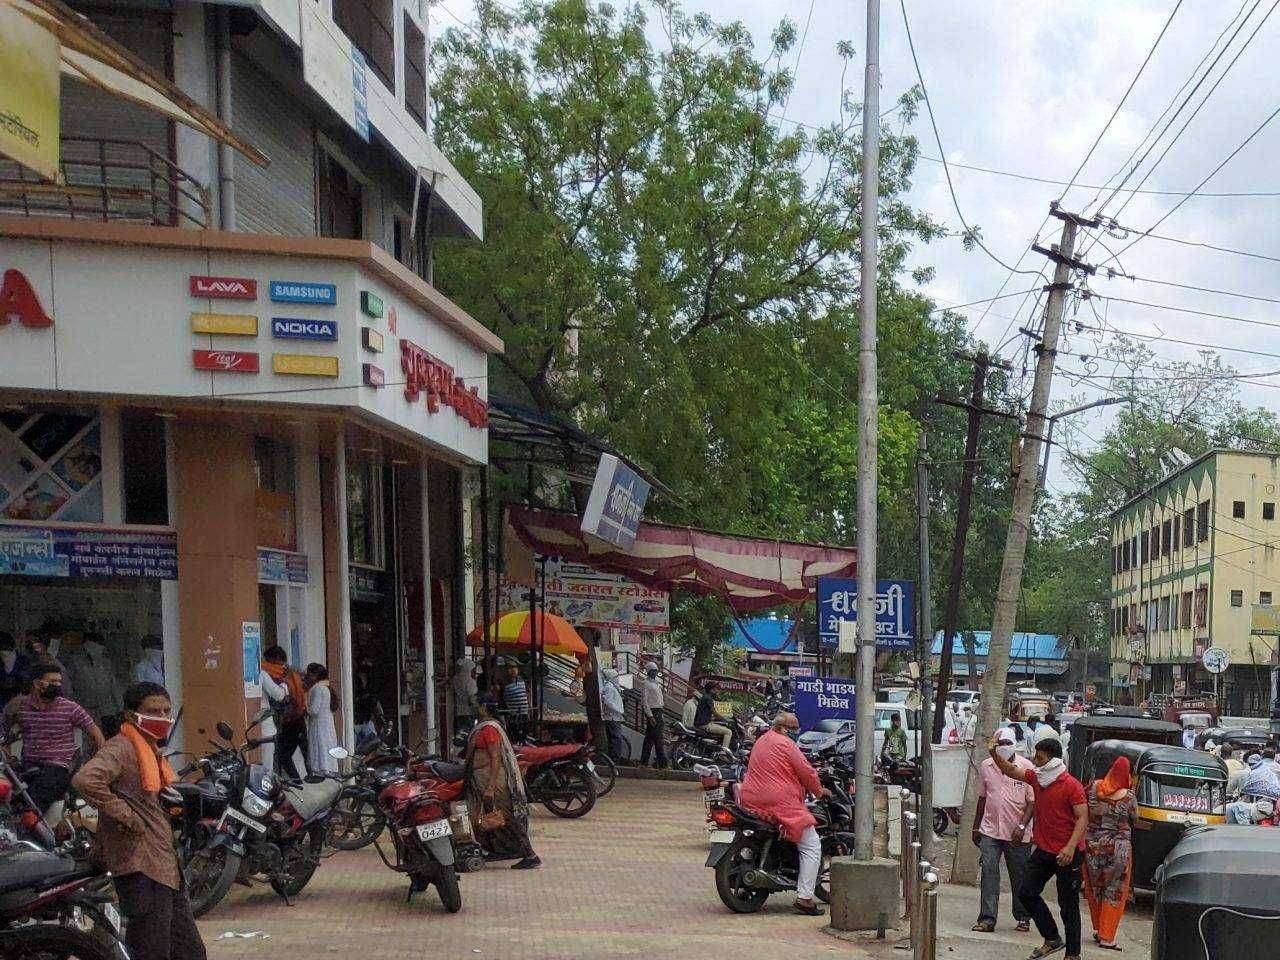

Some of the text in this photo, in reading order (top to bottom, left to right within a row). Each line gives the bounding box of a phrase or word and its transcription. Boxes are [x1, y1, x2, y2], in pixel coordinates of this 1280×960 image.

[197, 281, 248, 293] LAVA
[275, 285, 330, 298] SAMSUNG
[275, 321, 332, 335] NOKIA
